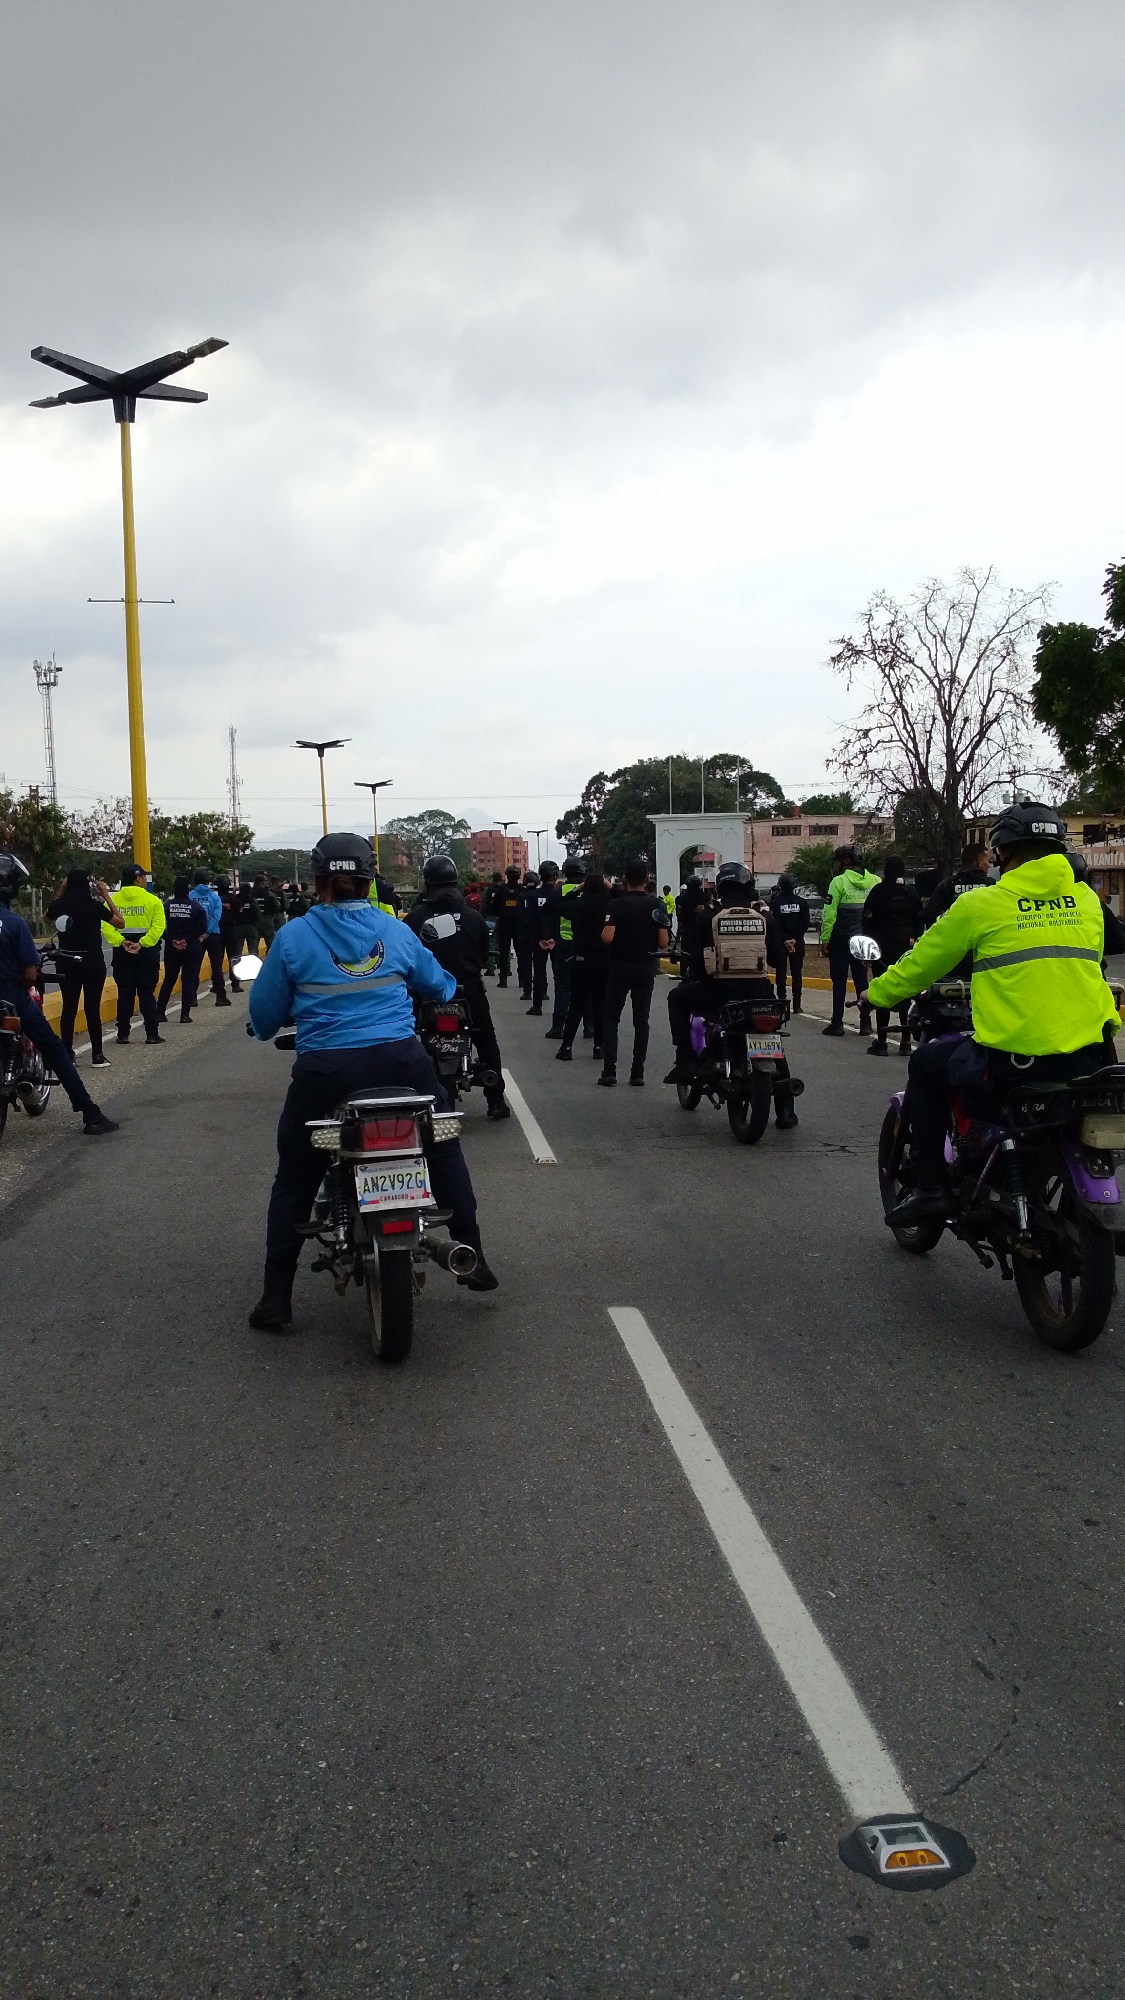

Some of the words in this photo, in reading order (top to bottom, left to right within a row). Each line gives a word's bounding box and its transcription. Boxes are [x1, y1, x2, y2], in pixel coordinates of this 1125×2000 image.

[1031, 822, 1058, 834] CPNB
[329, 860, 356, 871] CPNB
[1093, 852, 1125, 866] RANITA
[1017, 895, 1077, 912] CPNB
[441, 1043, 459, 1053] Dios
[363, 1171, 423, 1194] AN2V92G
